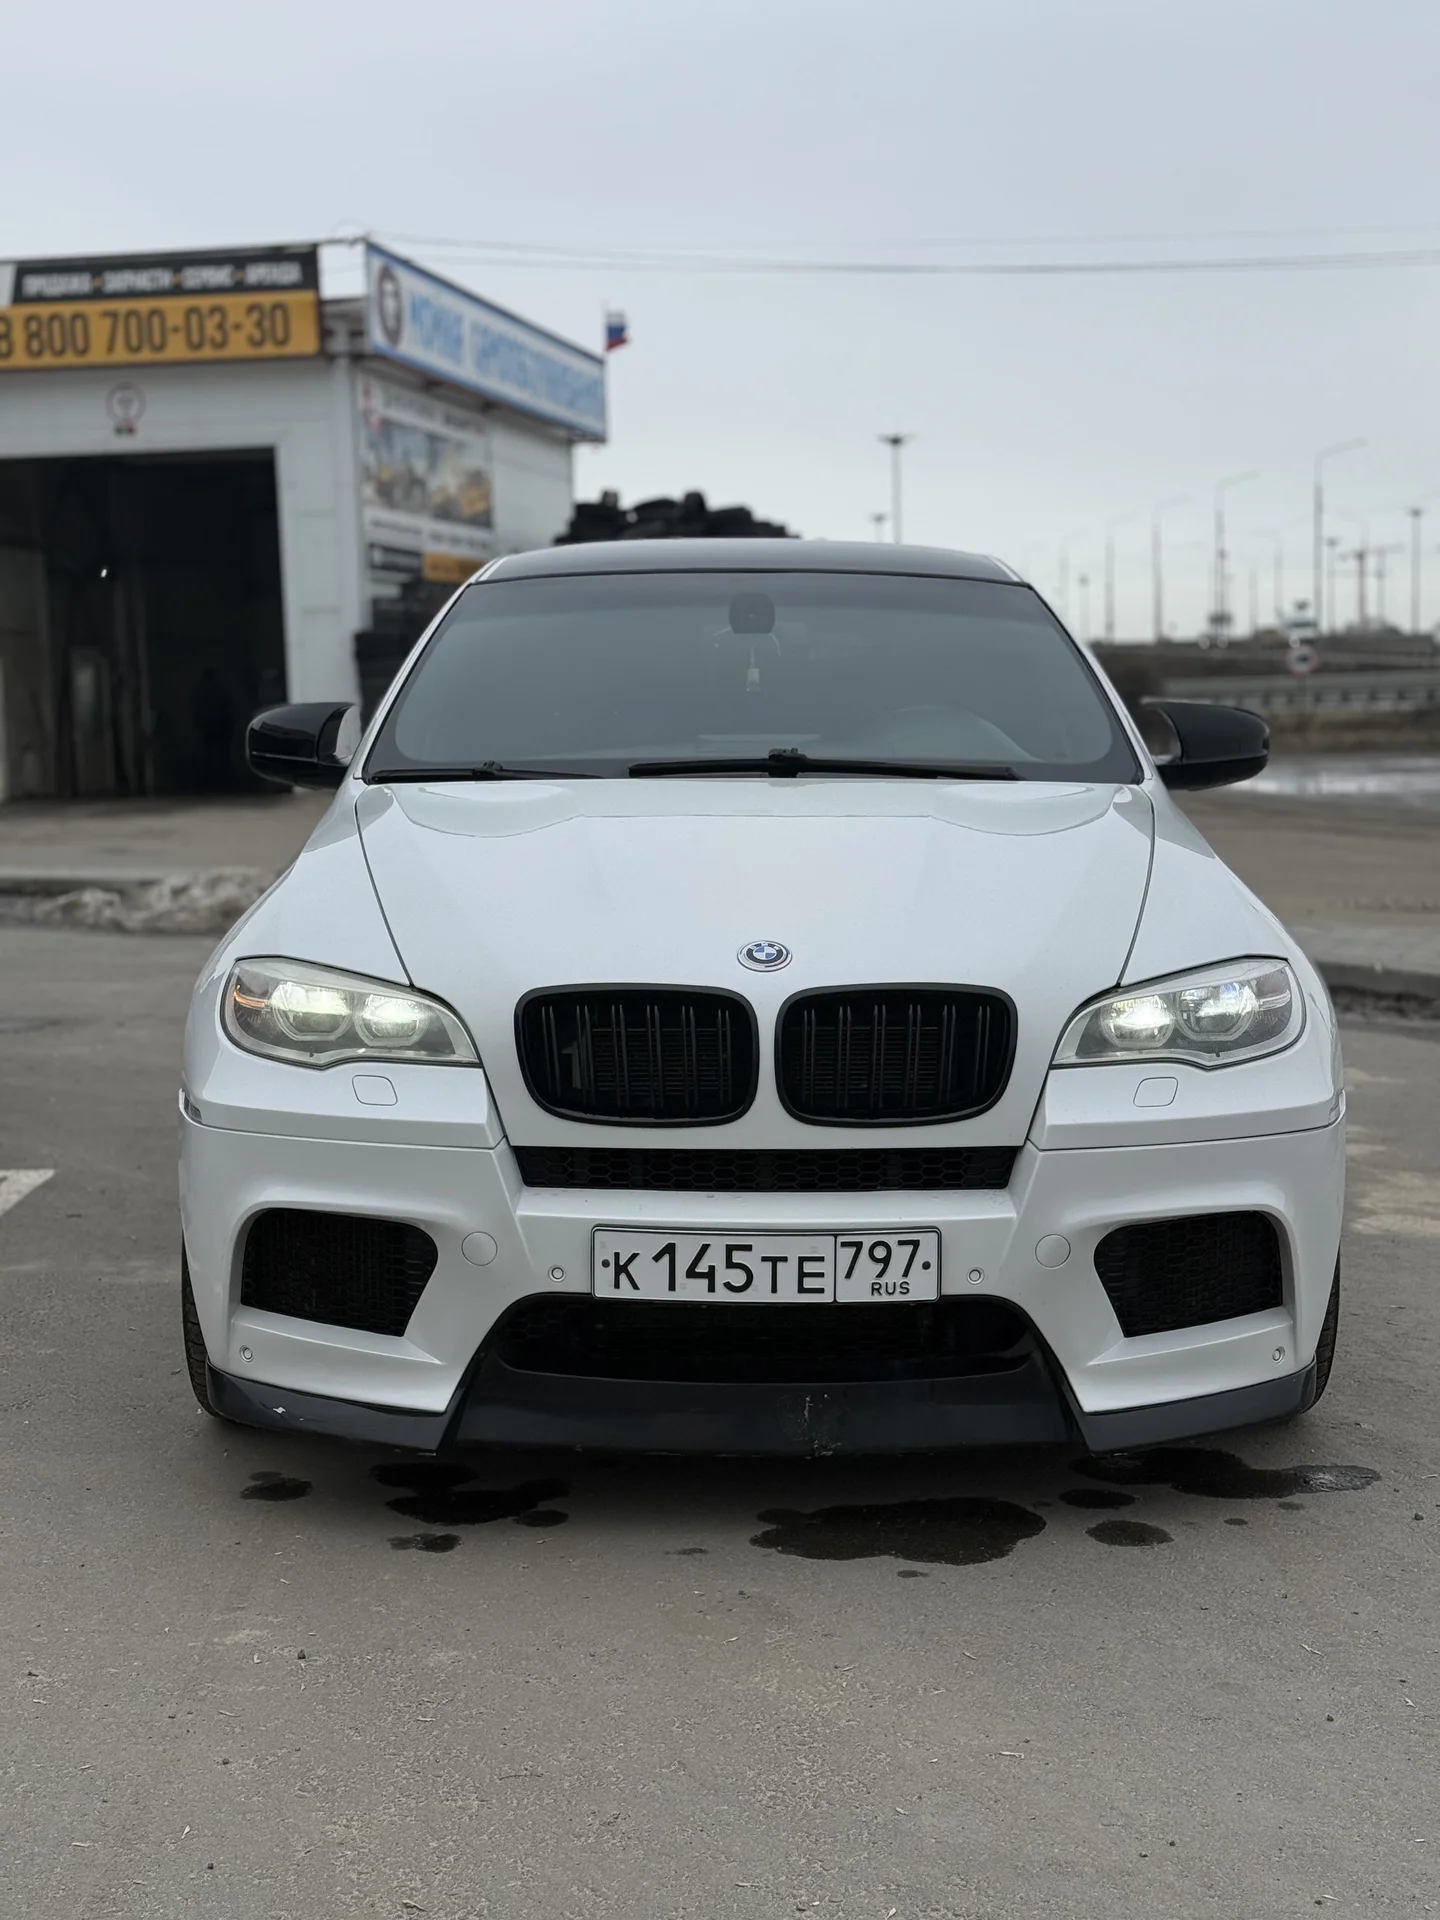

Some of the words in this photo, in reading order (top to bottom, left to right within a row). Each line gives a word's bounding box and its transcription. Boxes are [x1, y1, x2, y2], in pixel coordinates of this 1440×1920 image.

[24, 312, 90, 357] 800
[101, 302, 290, 354] 700-03-30
[840, 1239, 921, 1280] 797
[870, 1281, 911, 1296] RUS
